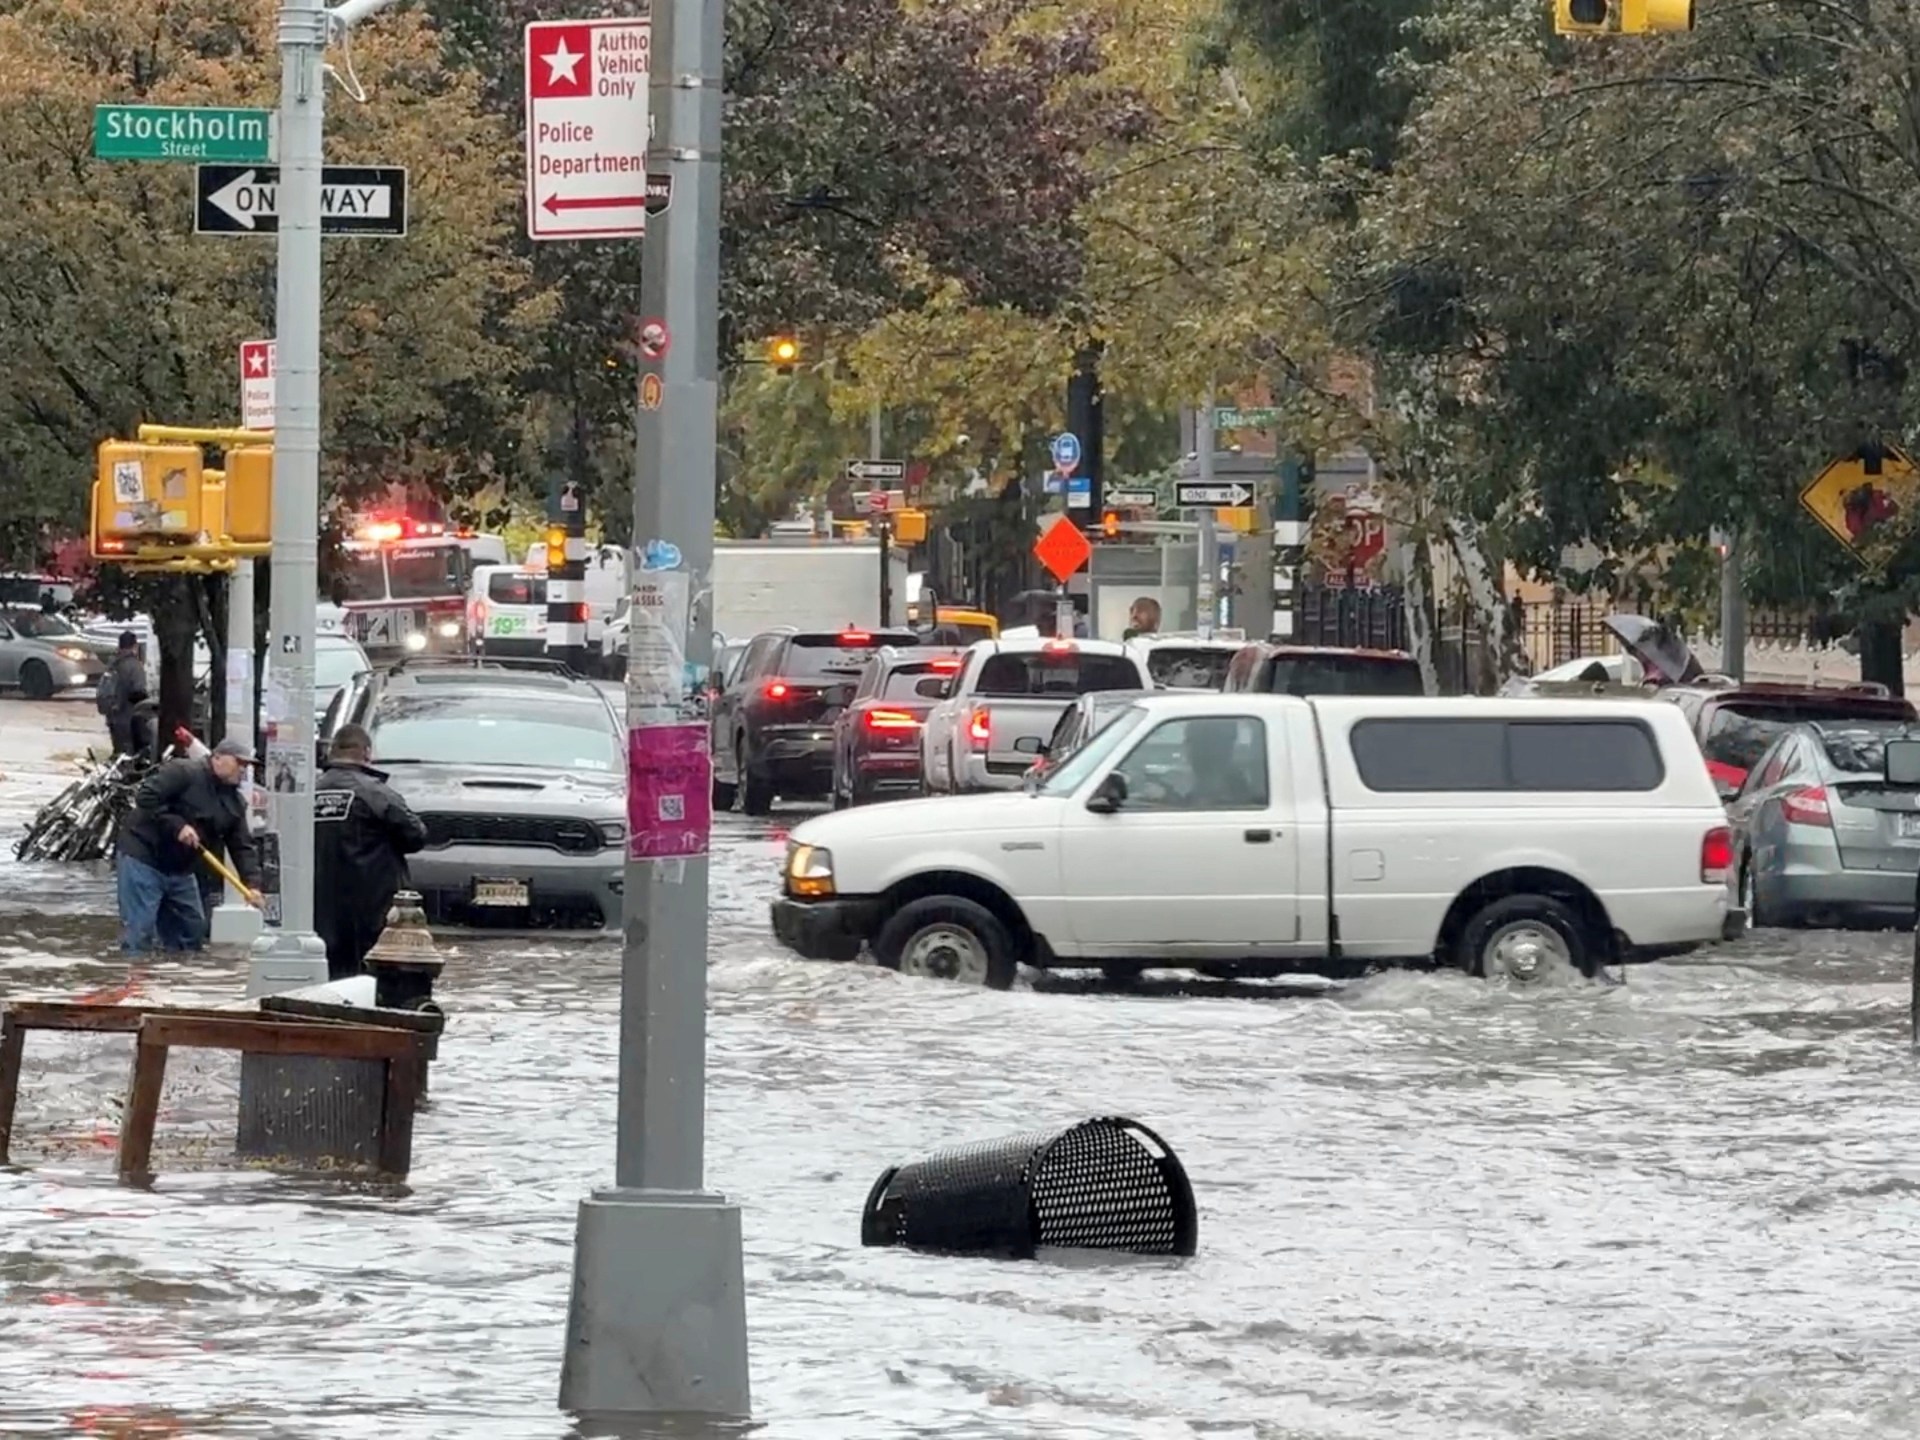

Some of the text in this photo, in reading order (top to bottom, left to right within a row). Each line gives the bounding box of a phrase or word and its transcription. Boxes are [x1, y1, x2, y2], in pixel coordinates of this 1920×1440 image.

[598, 32, 648, 51] Autho
[599, 54, 649, 74] Vehicl
[598, 78, 635, 100] Only
[106, 111, 263, 141] Stockholm
[539, 121, 593, 142] Police
[160, 141, 207, 157] Street
[539, 153, 646, 178] Department
[236, 187, 376, 213] ON WAY
[1185, 489, 1208, 500] ONE
